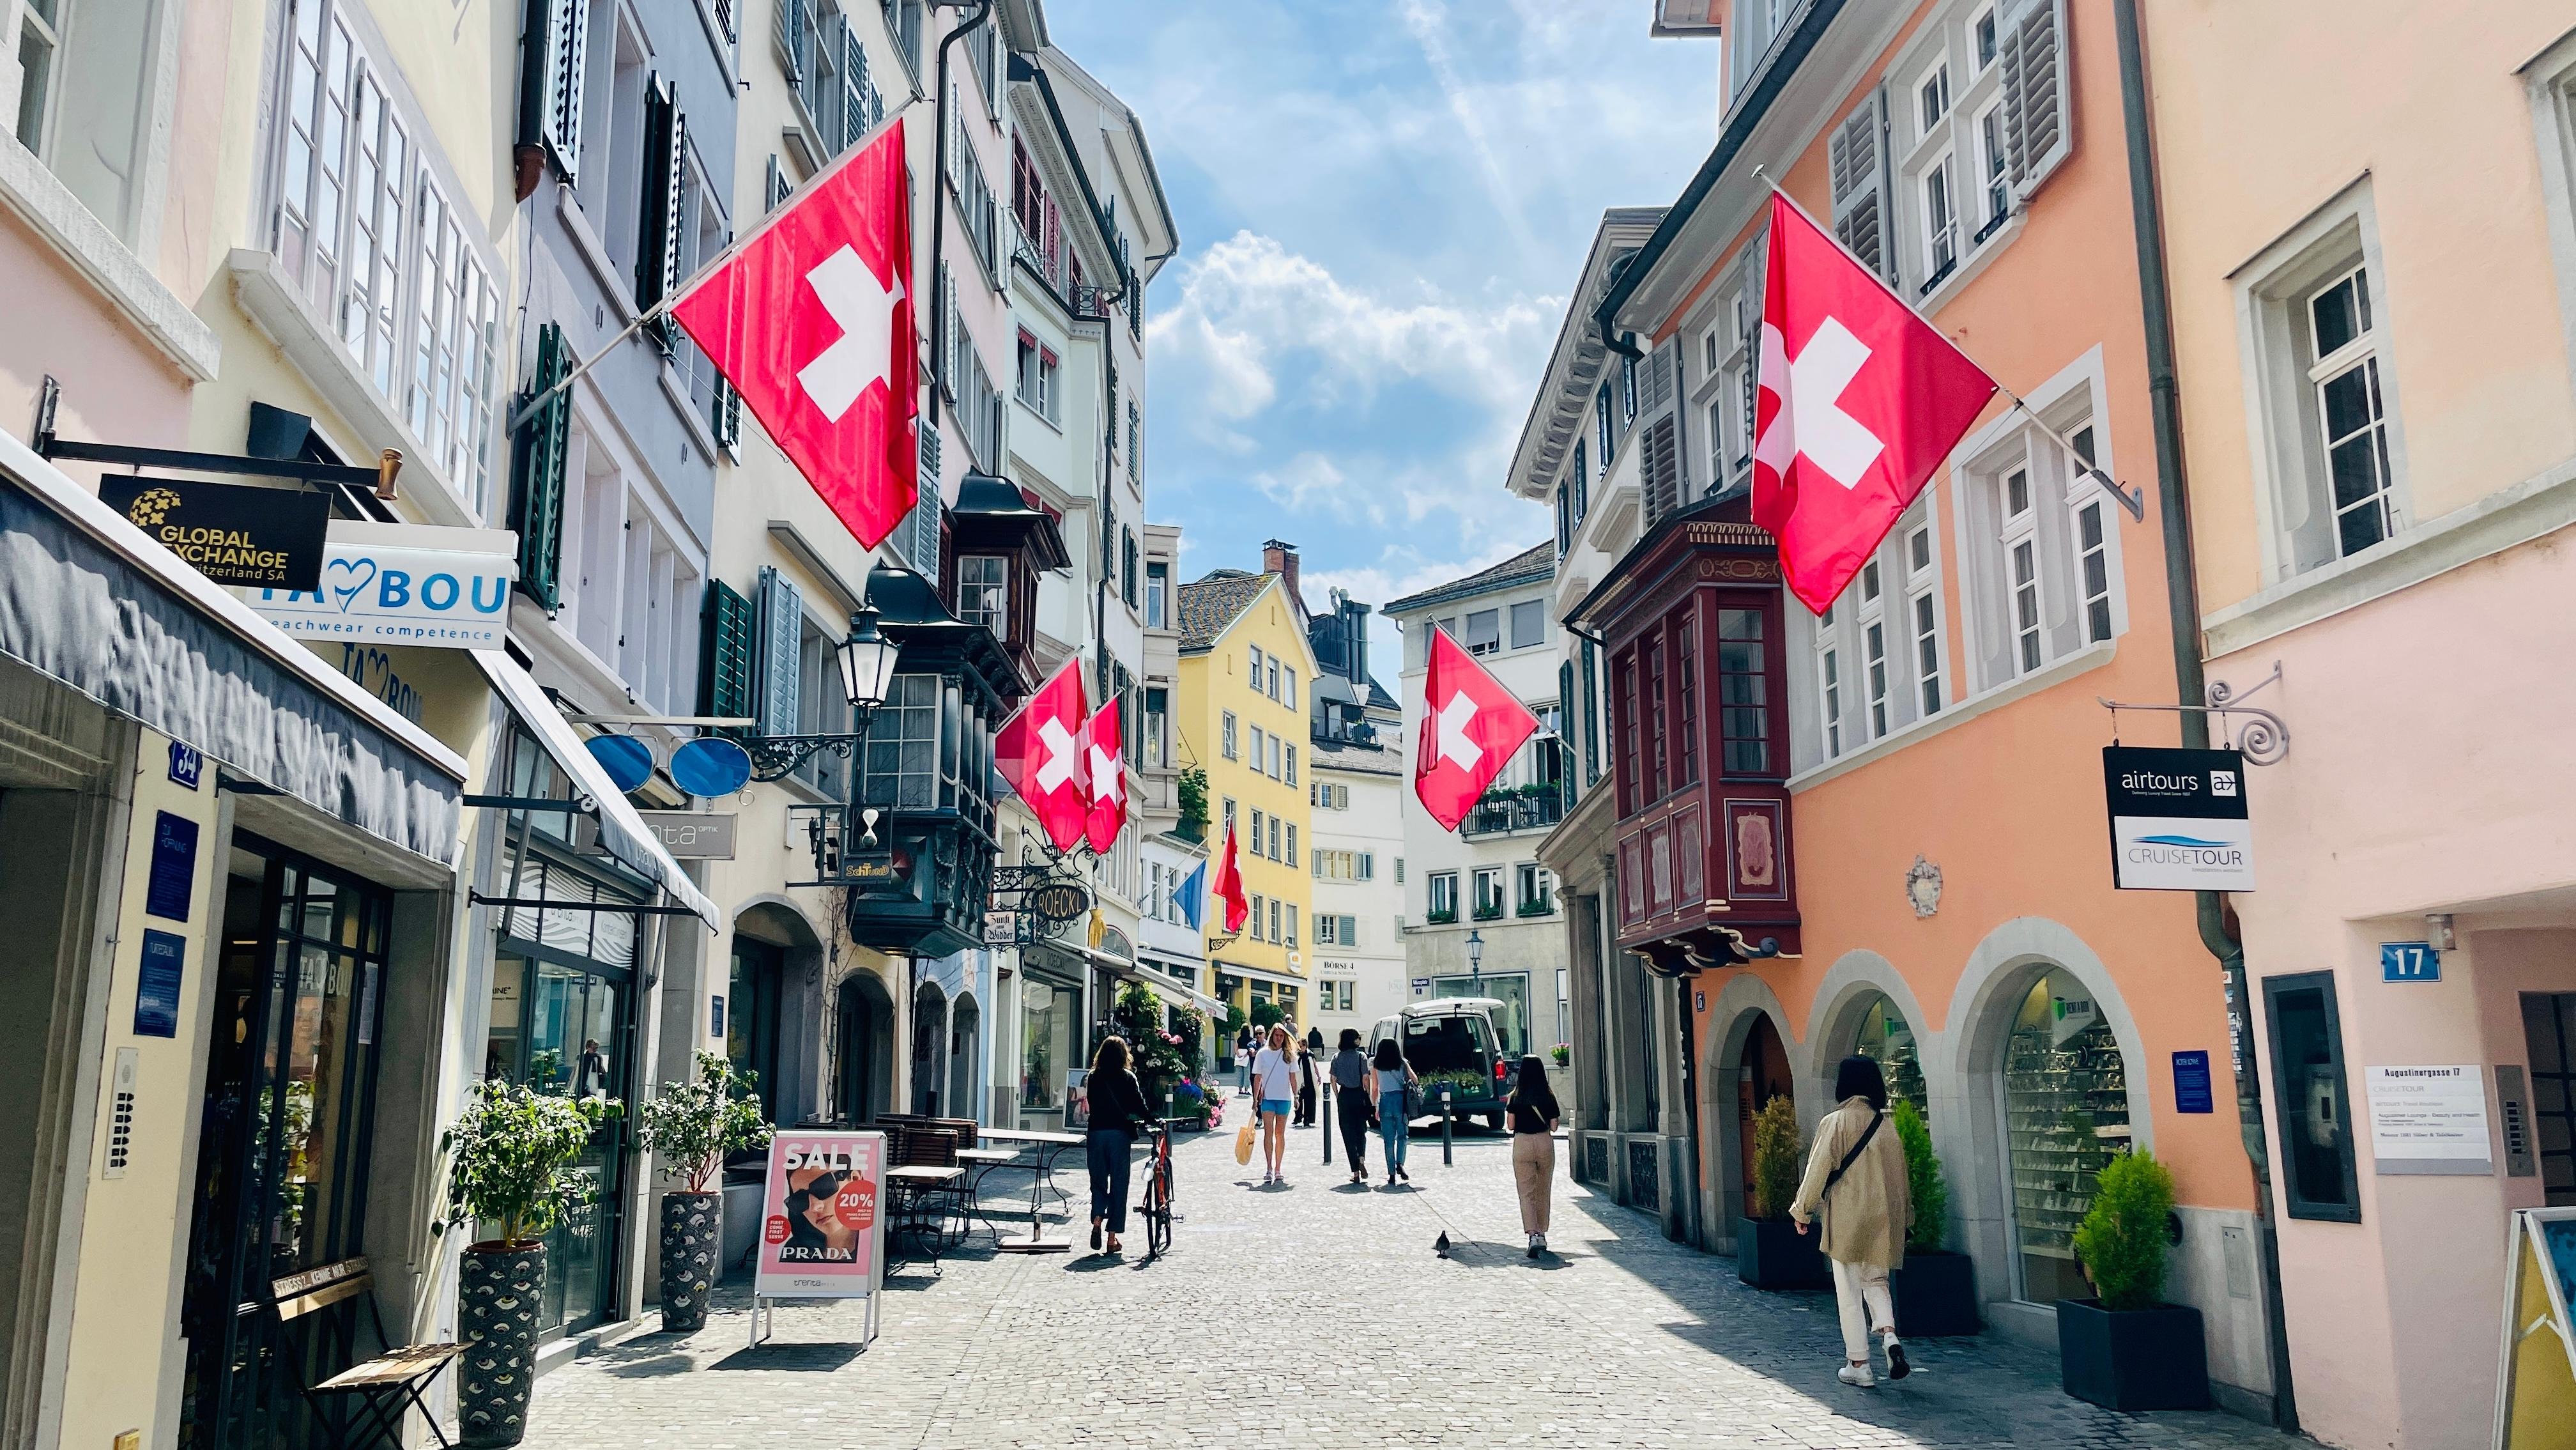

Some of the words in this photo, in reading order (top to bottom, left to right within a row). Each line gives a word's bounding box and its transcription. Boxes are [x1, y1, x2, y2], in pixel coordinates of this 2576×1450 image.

[160, 525, 256, 548] GLOBAL
[162, 543, 289, 569] XCHANGE
[267, 569, 286, 581] SA
[272, 619, 364, 634] eachwear
[376, 624, 492, 640] competence
[178, 744, 197, 780] 34
[2121, 770, 2199, 791] airtours
[698, 825, 719, 833] OPTIK
[2128, 847, 2243, 865] CRUISETOUR
[1038, 888, 1082, 918] ROECKL
[988, 930, 1014, 941] Widder
[1324, 960, 1347, 969] BÖRSE
[2395, 948, 2423, 975] 17
[2384, 1068, 2450, 1078] Augustinergasse
[2453, 1068, 2460, 1076] 17
[782, 1143, 871, 1171] SALE
[839, 1192, 873, 1207] 20%
[781, 1247, 852, 1260] PRADA
